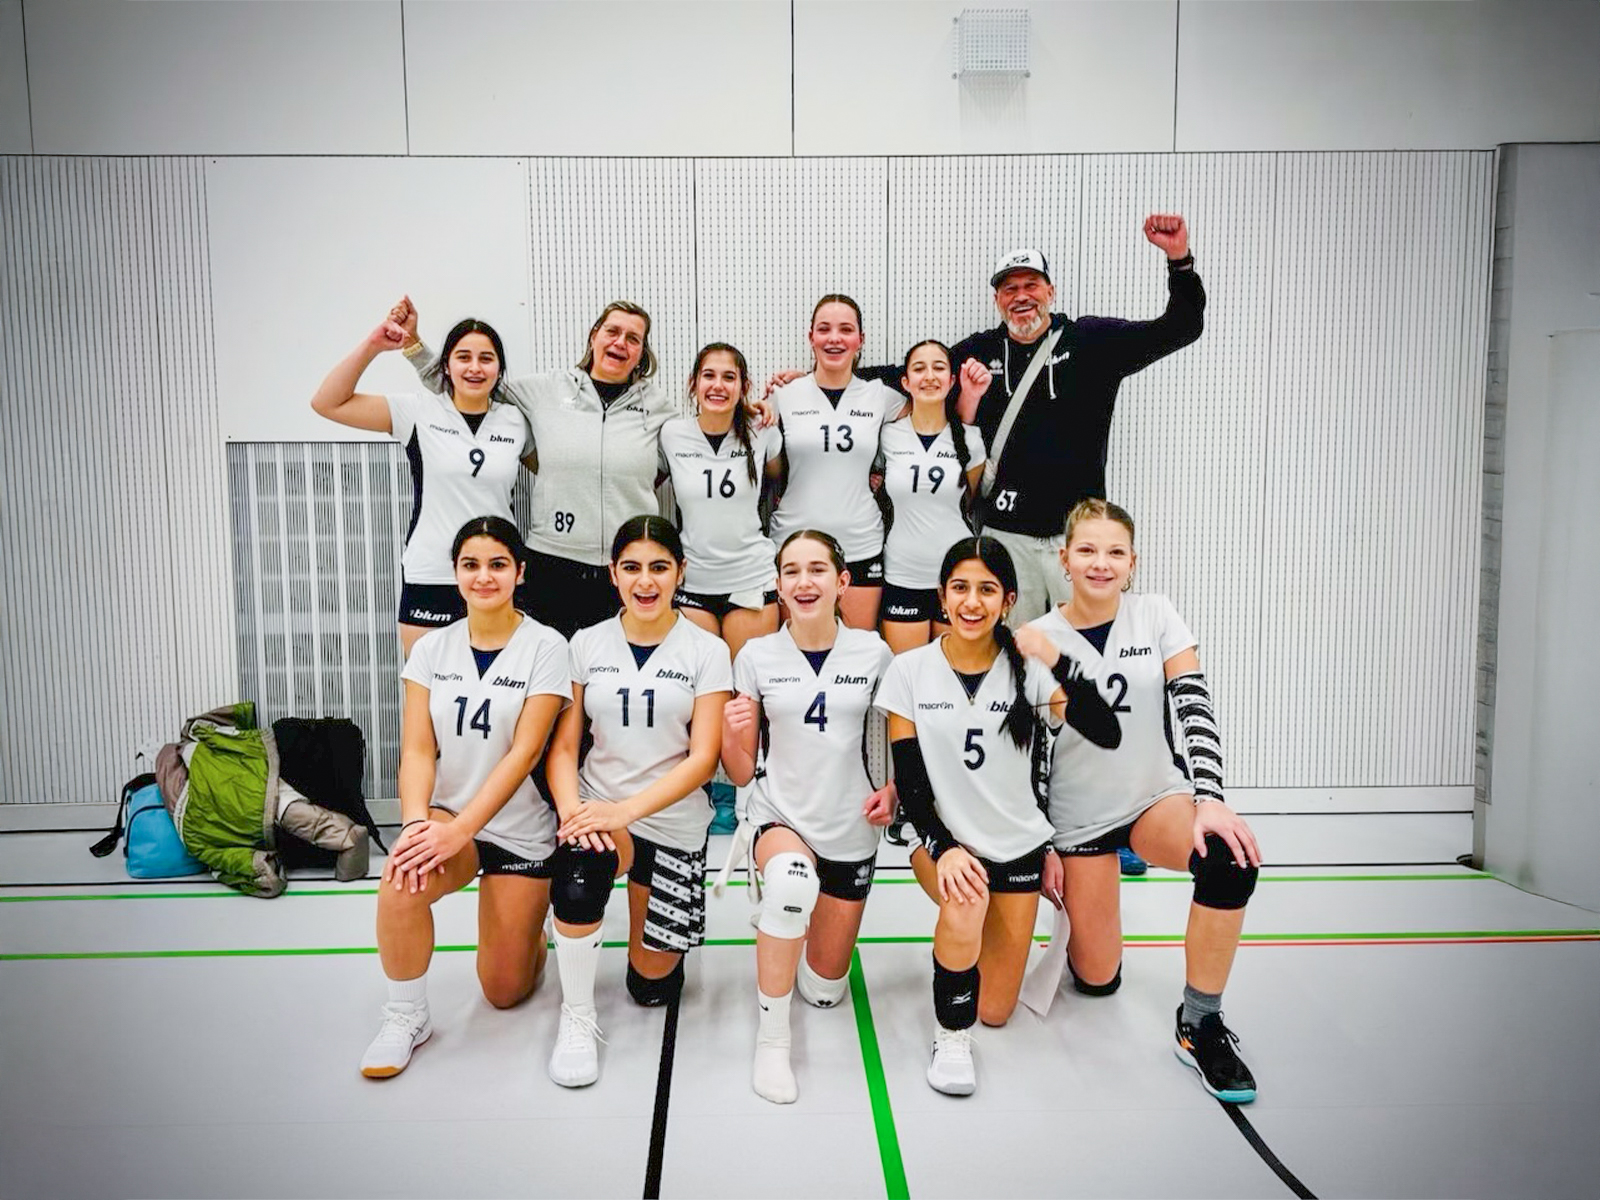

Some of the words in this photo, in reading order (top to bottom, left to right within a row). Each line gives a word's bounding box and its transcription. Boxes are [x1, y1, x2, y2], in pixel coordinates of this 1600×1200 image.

[849, 409, 874, 418] blum
[489, 434, 515, 444] blum
[820, 424, 854, 453] 13
[469, 448, 485, 478] 9
[702, 468, 736, 499] 16
[910, 464, 945, 494] 19
[995, 489, 1018, 512] 67
[555, 511, 575, 534] 89
[413, 608, 451, 622] blum
[890, 604, 919, 616] blum
[1119, 646, 1152, 659] blum
[492, 675, 526, 689] blum
[655, 668, 689, 682] blum
[768, 675, 801, 684] macron
[834, 674, 868, 685] blum
[616, 687, 655, 728] 11
[804, 691, 828, 732] 4
[918, 701, 954, 710] macron
[989, 701, 1014, 713] blu
[454, 695, 491, 739] 14
[963, 728, 986, 771] 5
